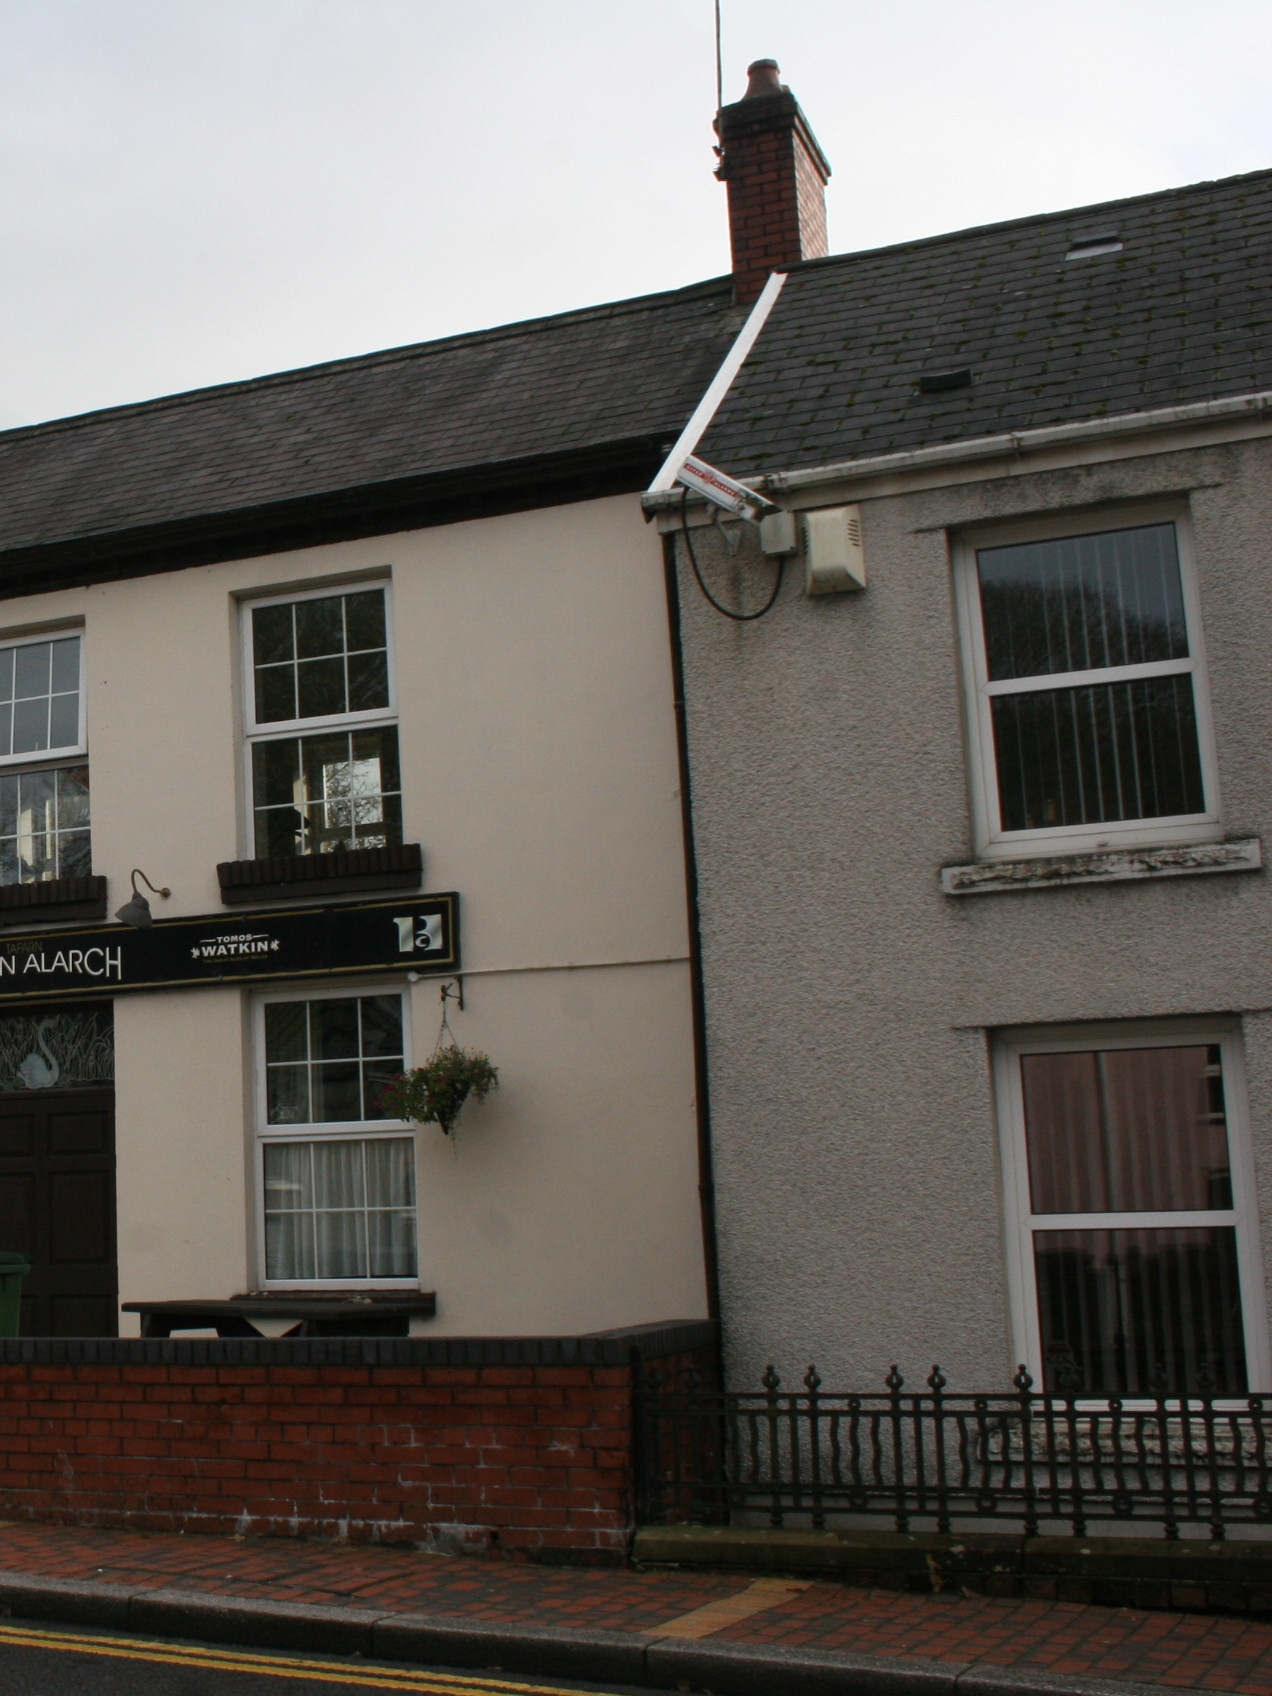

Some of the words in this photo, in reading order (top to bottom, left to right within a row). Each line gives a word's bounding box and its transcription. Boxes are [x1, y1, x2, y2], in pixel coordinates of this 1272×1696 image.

[216, 933, 253, 943] TOMOS
[6, 941, 43, 954] TAFARN
[201, 940, 269, 957] WATKIN
[23, 945, 122, 981] ALARCH
